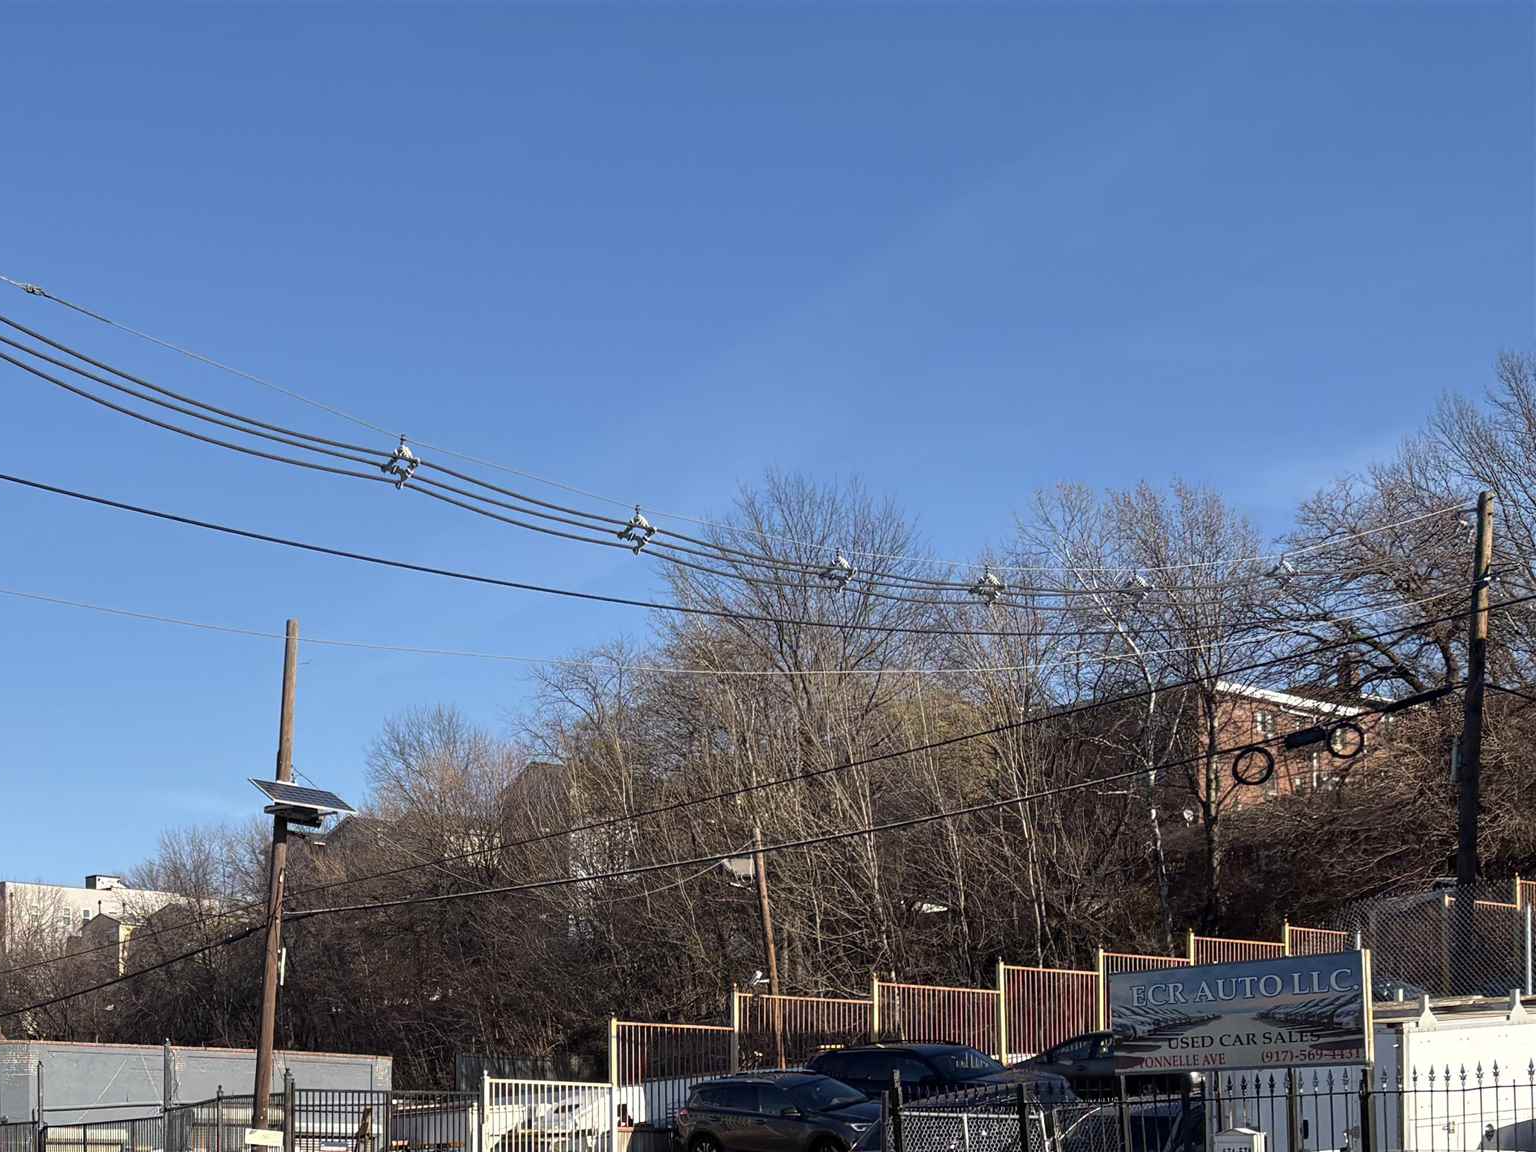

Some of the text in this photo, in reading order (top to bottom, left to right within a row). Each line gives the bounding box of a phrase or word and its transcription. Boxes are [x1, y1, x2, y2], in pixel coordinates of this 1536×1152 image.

[1131, 968, 1360, 1007] ECR AUTO LLC.
[1167, 1030, 1321, 1049] USED CAR SALES
[1202, 1052, 1226, 1065] AVE
